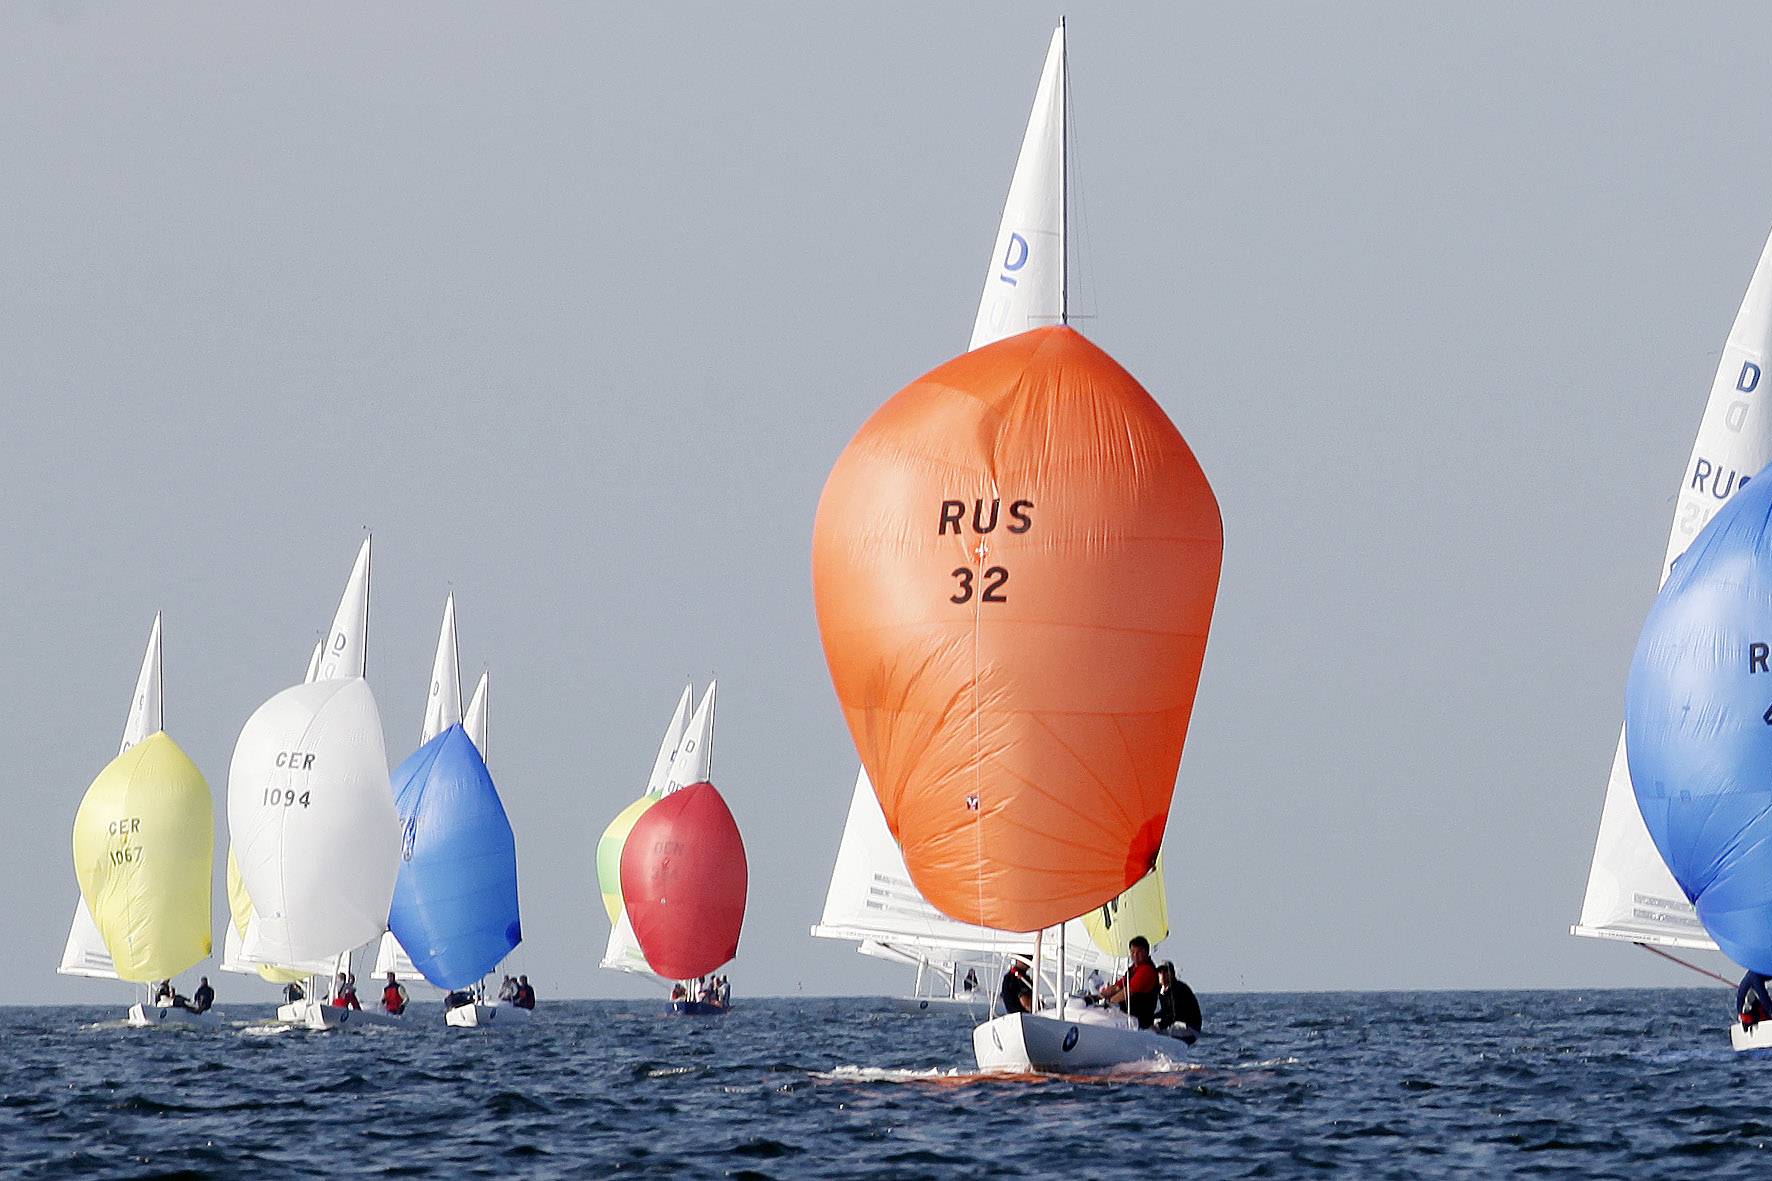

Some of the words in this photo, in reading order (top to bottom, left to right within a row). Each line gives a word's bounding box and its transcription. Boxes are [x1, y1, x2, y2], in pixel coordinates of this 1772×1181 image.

[1003, 231, 1029, 272] D
[1736, 360, 1762, 393] D
[938, 498, 1035, 536] RUS
[950, 566, 1010, 605] 32
[333, 632, 347, 652] D
[275, 751, 316, 771] GER
[263, 787, 311, 809] 1094
[108, 817, 141, 837] GER
[109, 845, 143, 868] 1067
